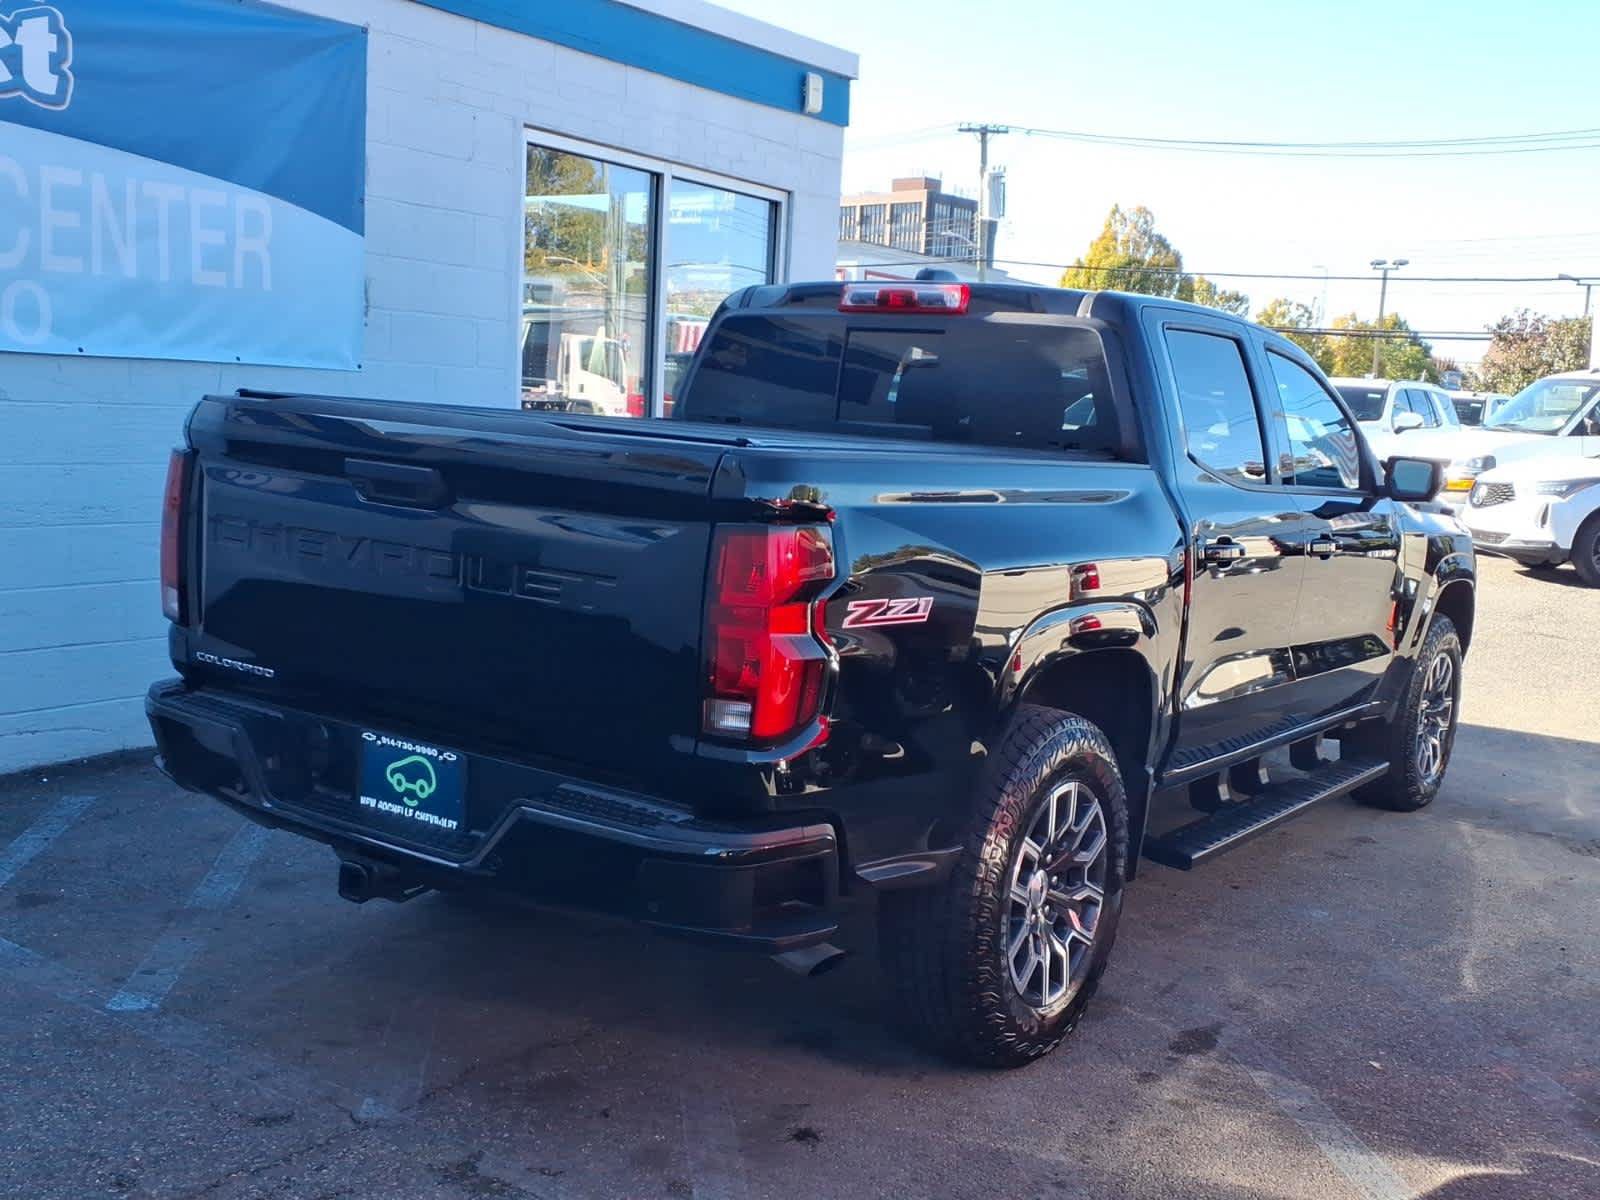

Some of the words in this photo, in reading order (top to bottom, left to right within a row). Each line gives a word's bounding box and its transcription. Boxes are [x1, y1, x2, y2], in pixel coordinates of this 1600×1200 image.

[208, 517, 620, 611] CHEVROLET
[842, 597, 934, 629] Z71
[196, 651, 274, 678] COLORADO
[360, 796, 377, 808] NEW
